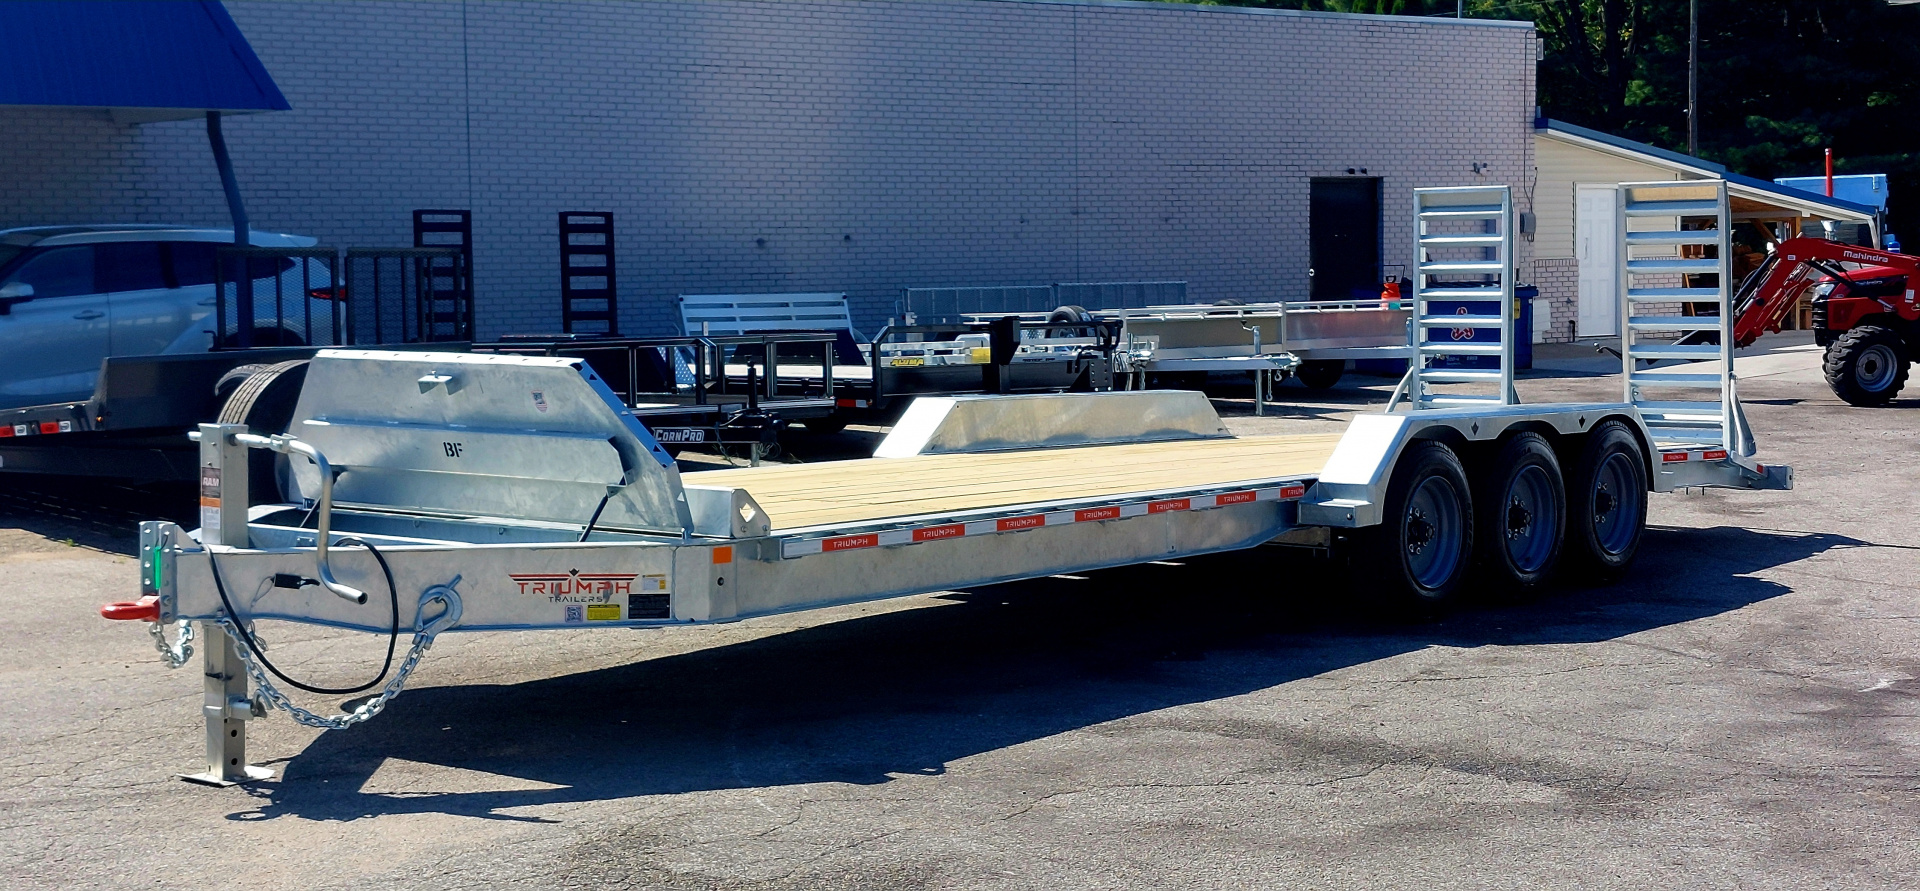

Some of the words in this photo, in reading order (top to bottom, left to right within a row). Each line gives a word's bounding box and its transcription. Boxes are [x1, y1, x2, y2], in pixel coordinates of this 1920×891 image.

[1843, 250, 1889, 263] Mahindra
[443, 441, 463, 458] BF
[202, 477, 220, 487] RAM
[1223, 494, 1250, 503] TRIUMPH
[1156, 502, 1183, 511] TRIUMPH
[1083, 510, 1112, 519] TRIUMPH
[1005, 517, 1037, 528] TRIUMPH
[922, 528, 956, 539] TRIUMPH
[832, 538, 868, 548] TRIUMPH
[516, 579, 632, 595] TRIUMPH
